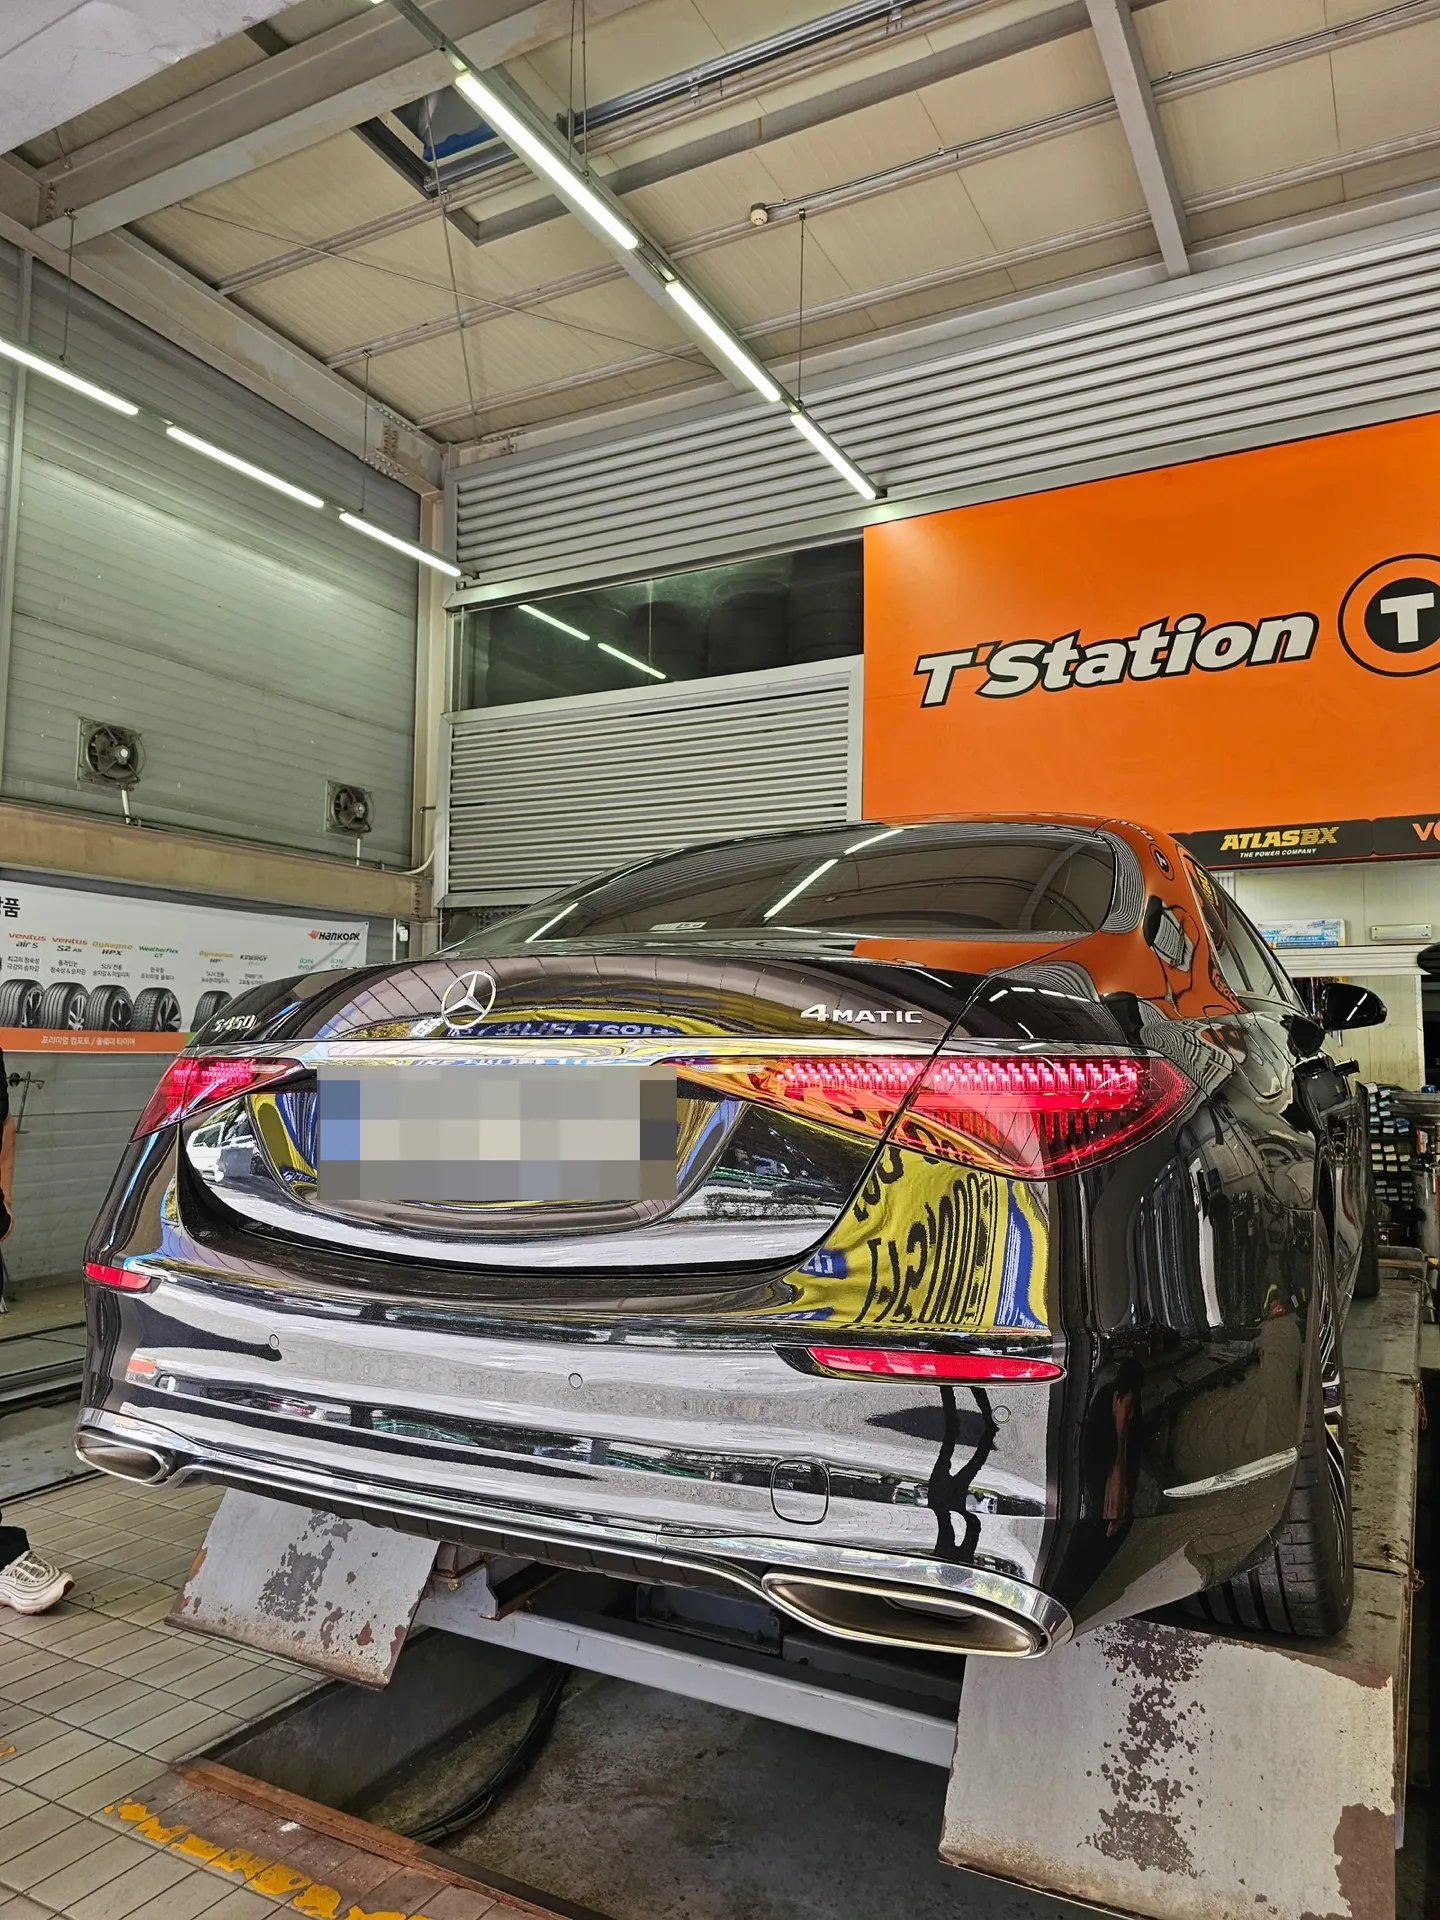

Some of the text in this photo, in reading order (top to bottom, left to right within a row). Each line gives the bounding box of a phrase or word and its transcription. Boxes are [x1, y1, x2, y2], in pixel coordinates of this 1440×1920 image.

[1220, 827, 1339, 850] ATLASBX
[1412, 822, 1440, 841] V
[1281, 848, 1317, 856] COMPANY
[0, 896, 21, 918] 품
[800, 1003, 923, 1024] 4MATIC
